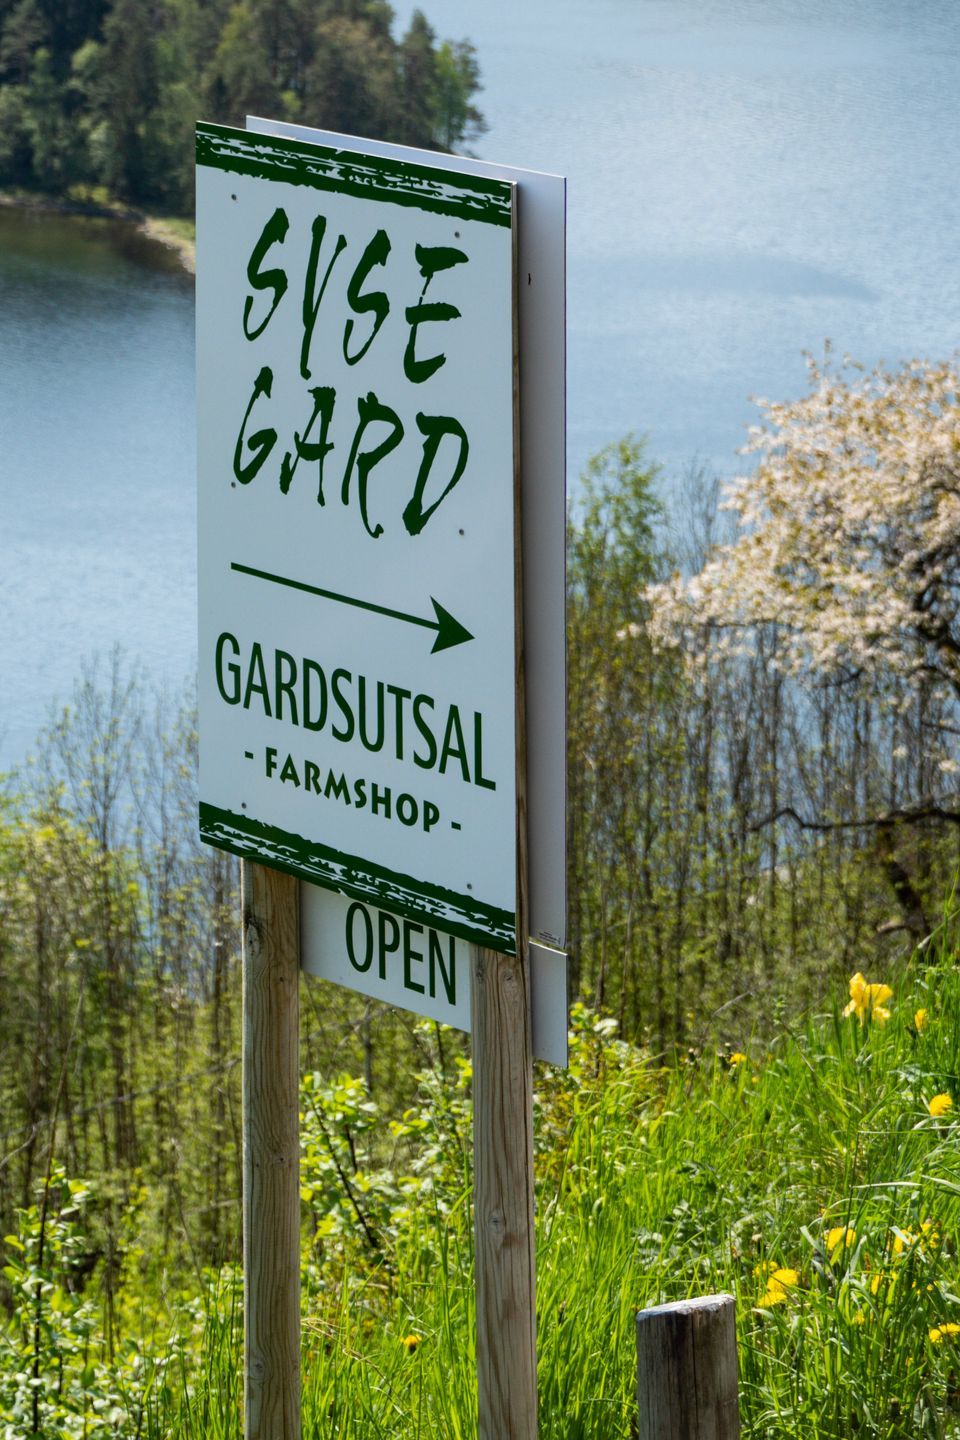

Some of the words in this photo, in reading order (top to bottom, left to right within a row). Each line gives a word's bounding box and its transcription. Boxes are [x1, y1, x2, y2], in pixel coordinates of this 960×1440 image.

[243, 207, 469, 384] SYSE
[233, 366, 470, 539] GARD
[215, 631, 497, 792] GARDSUTSAL
[345, 901, 456, 1007] OPEN
